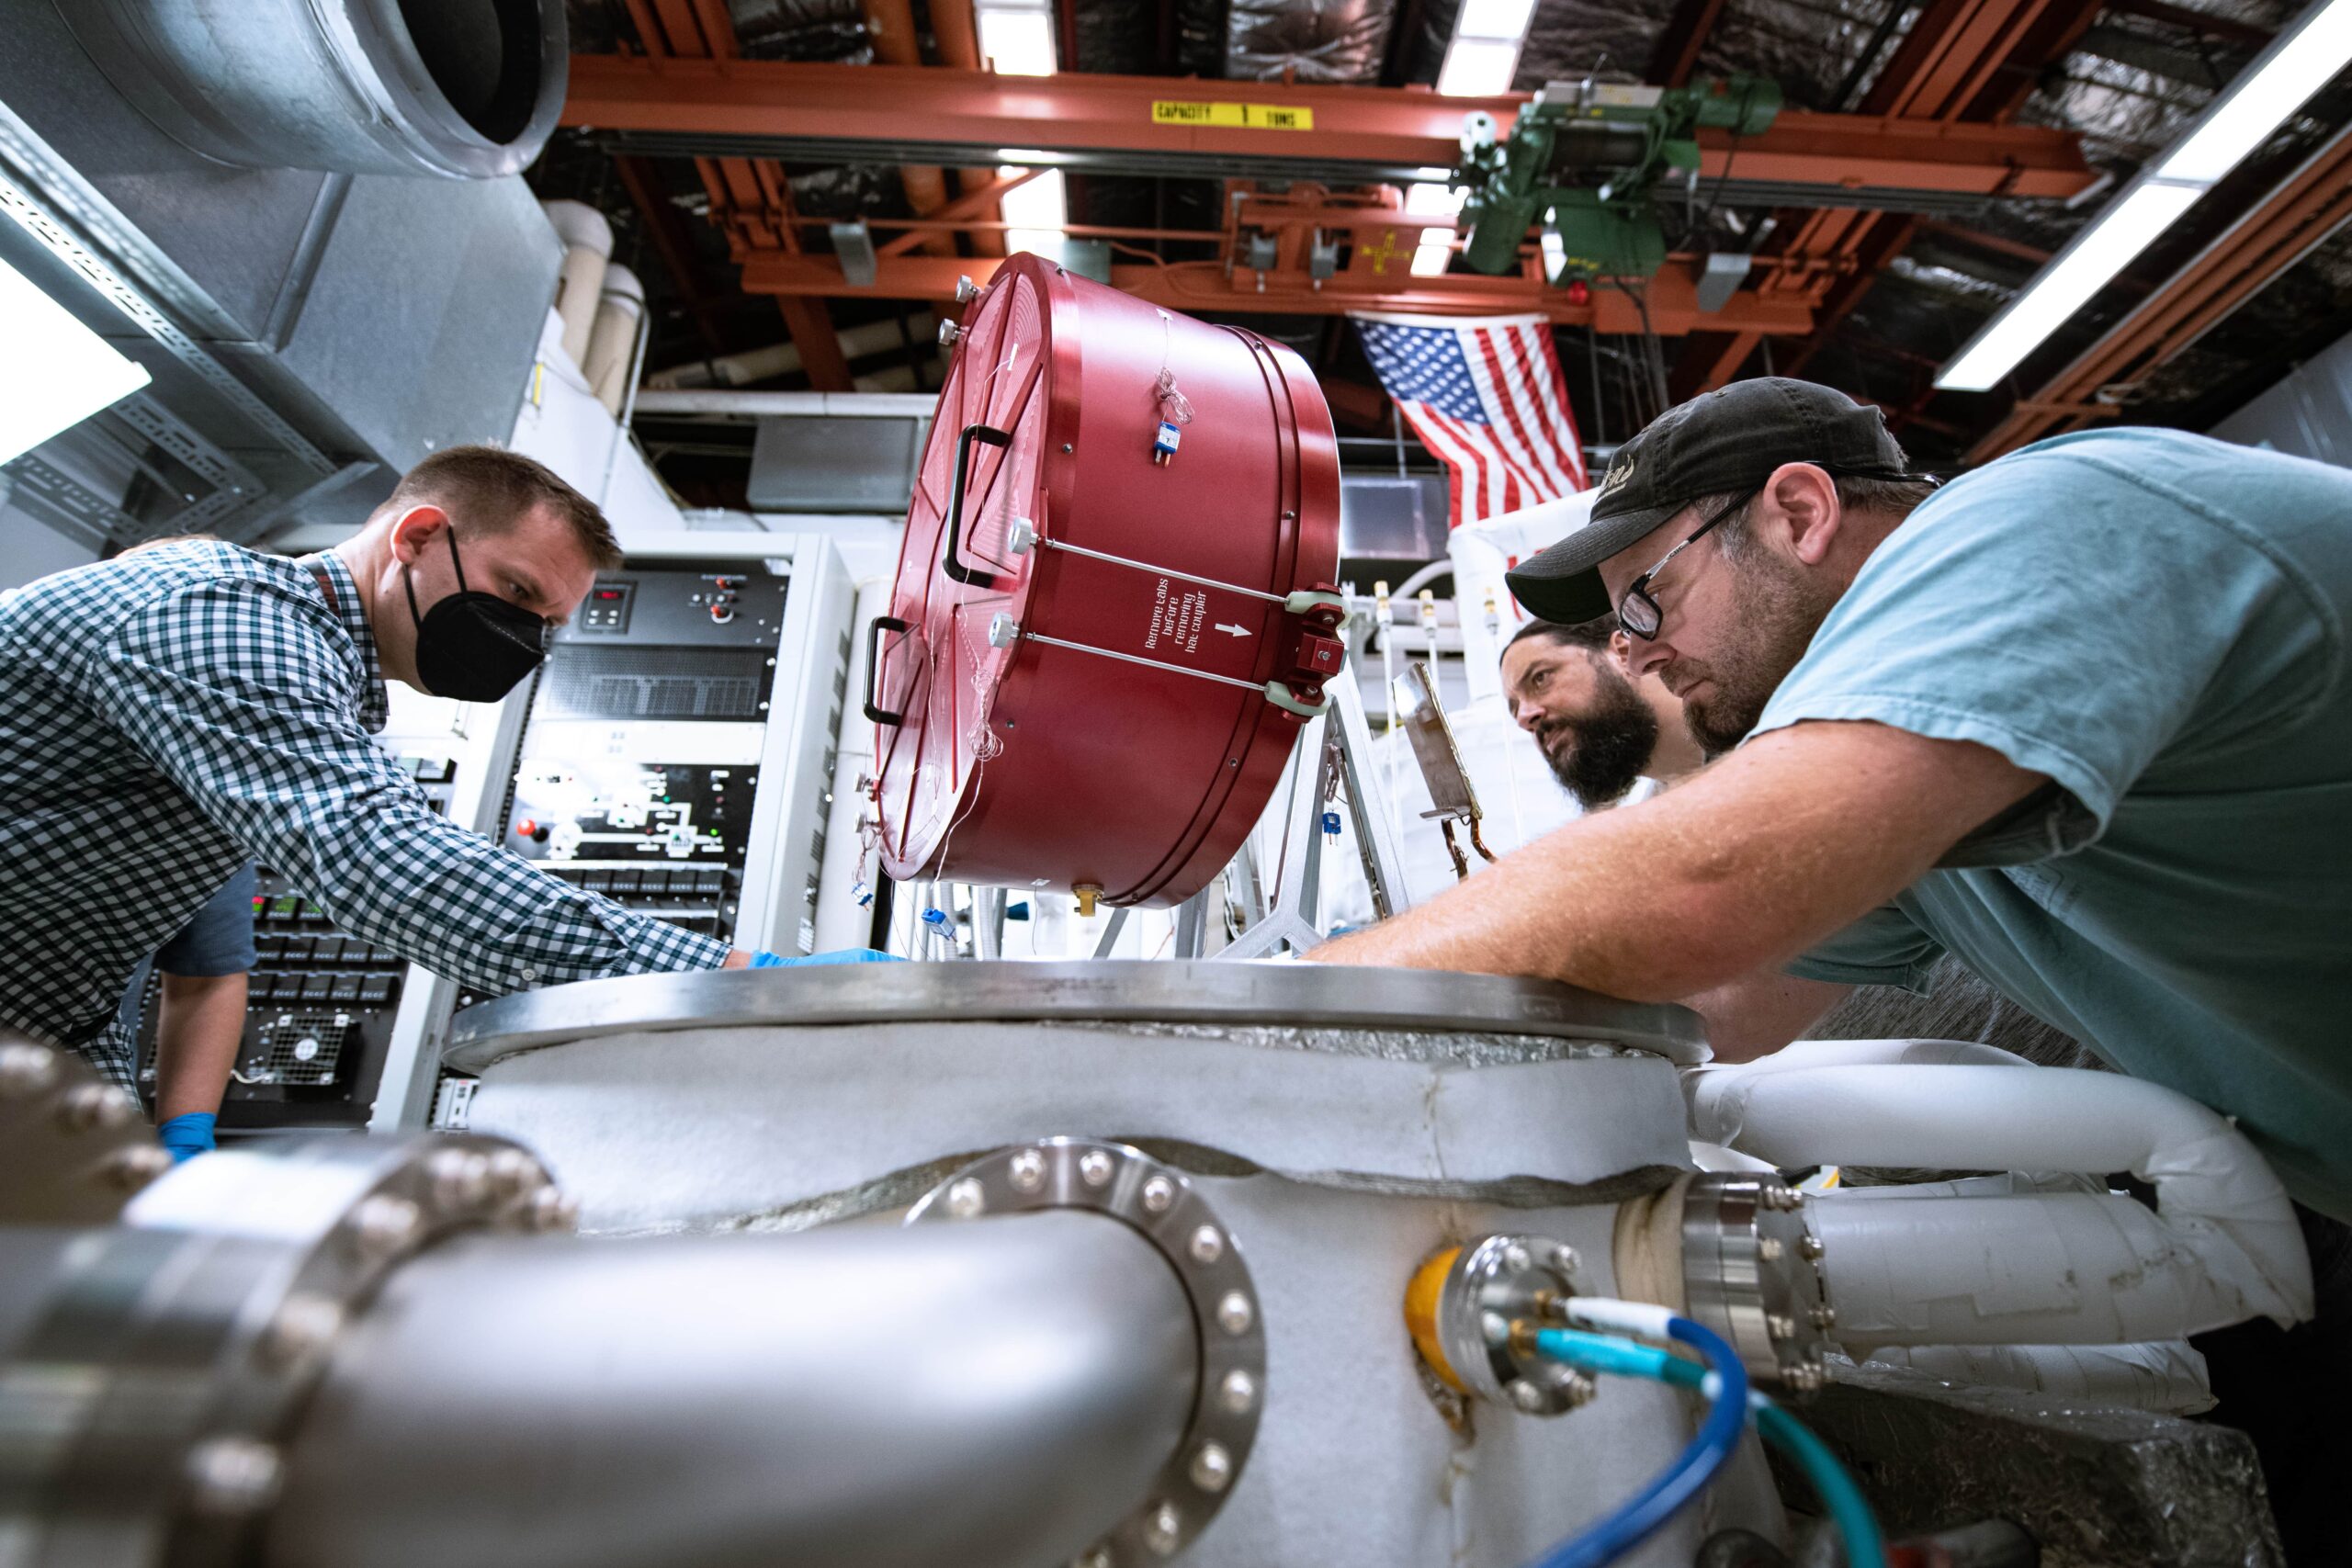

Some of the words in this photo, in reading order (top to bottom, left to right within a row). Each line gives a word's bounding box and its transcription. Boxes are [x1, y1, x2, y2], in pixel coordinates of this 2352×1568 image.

[1157, 102, 1211, 119] CAPACITY
[1242, 103, 1249, 124] 1
[1145, 606, 1163, 649] Remove
[1156, 578, 1169, 604] tabs
[1161, 597, 1179, 636] before
[1175, 592, 1196, 645] removing
[1191, 591, 1207, 632] coupler
[1184, 634, 1199, 653] hat
